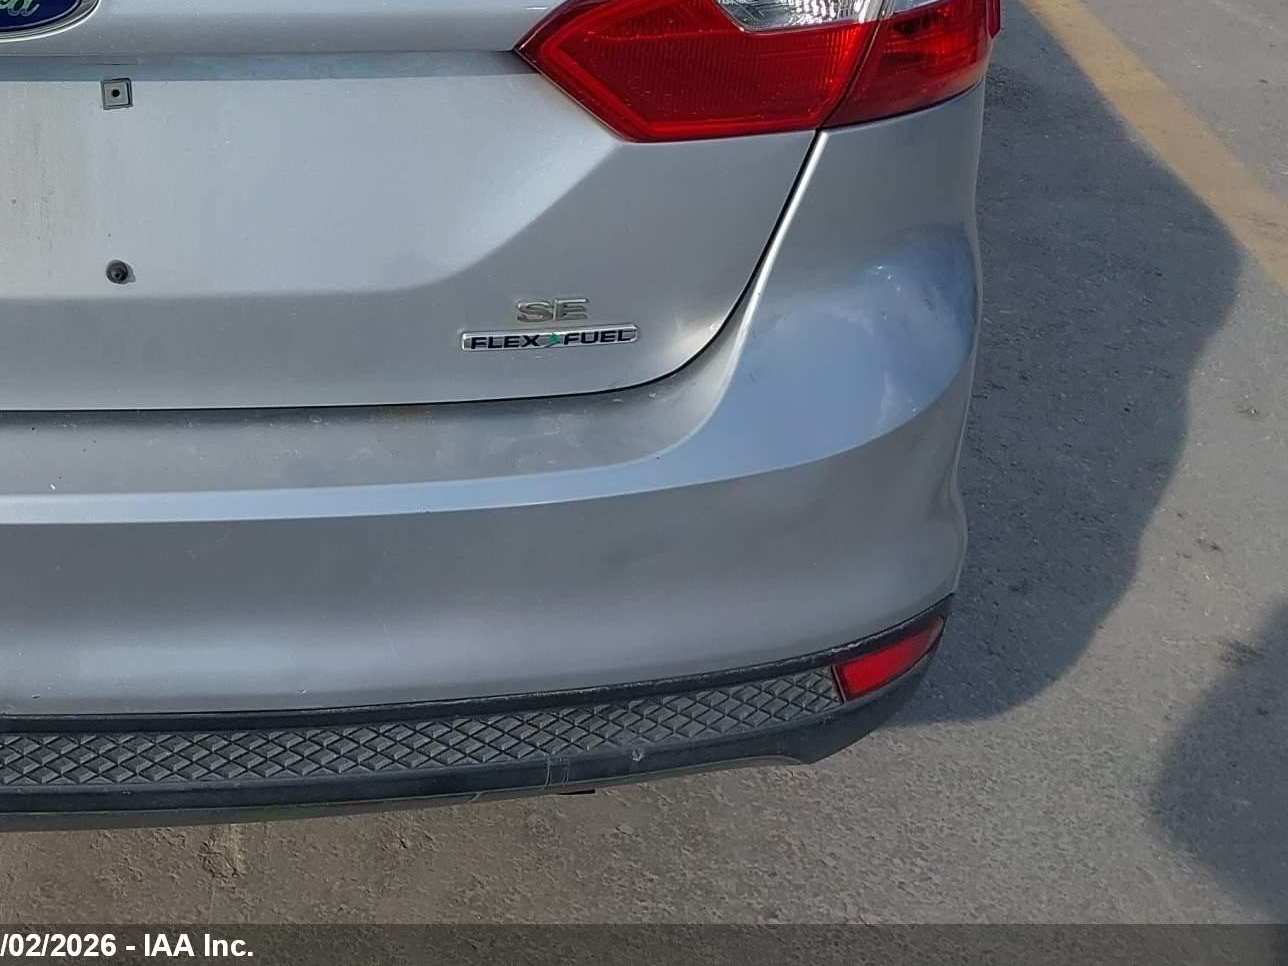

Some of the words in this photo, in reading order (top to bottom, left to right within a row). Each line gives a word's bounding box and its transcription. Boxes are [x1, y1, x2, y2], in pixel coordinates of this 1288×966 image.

[516, 298, 590, 323] SE
[470, 334, 540, 350] FLEX
[563, 327, 634, 346] FUEL
